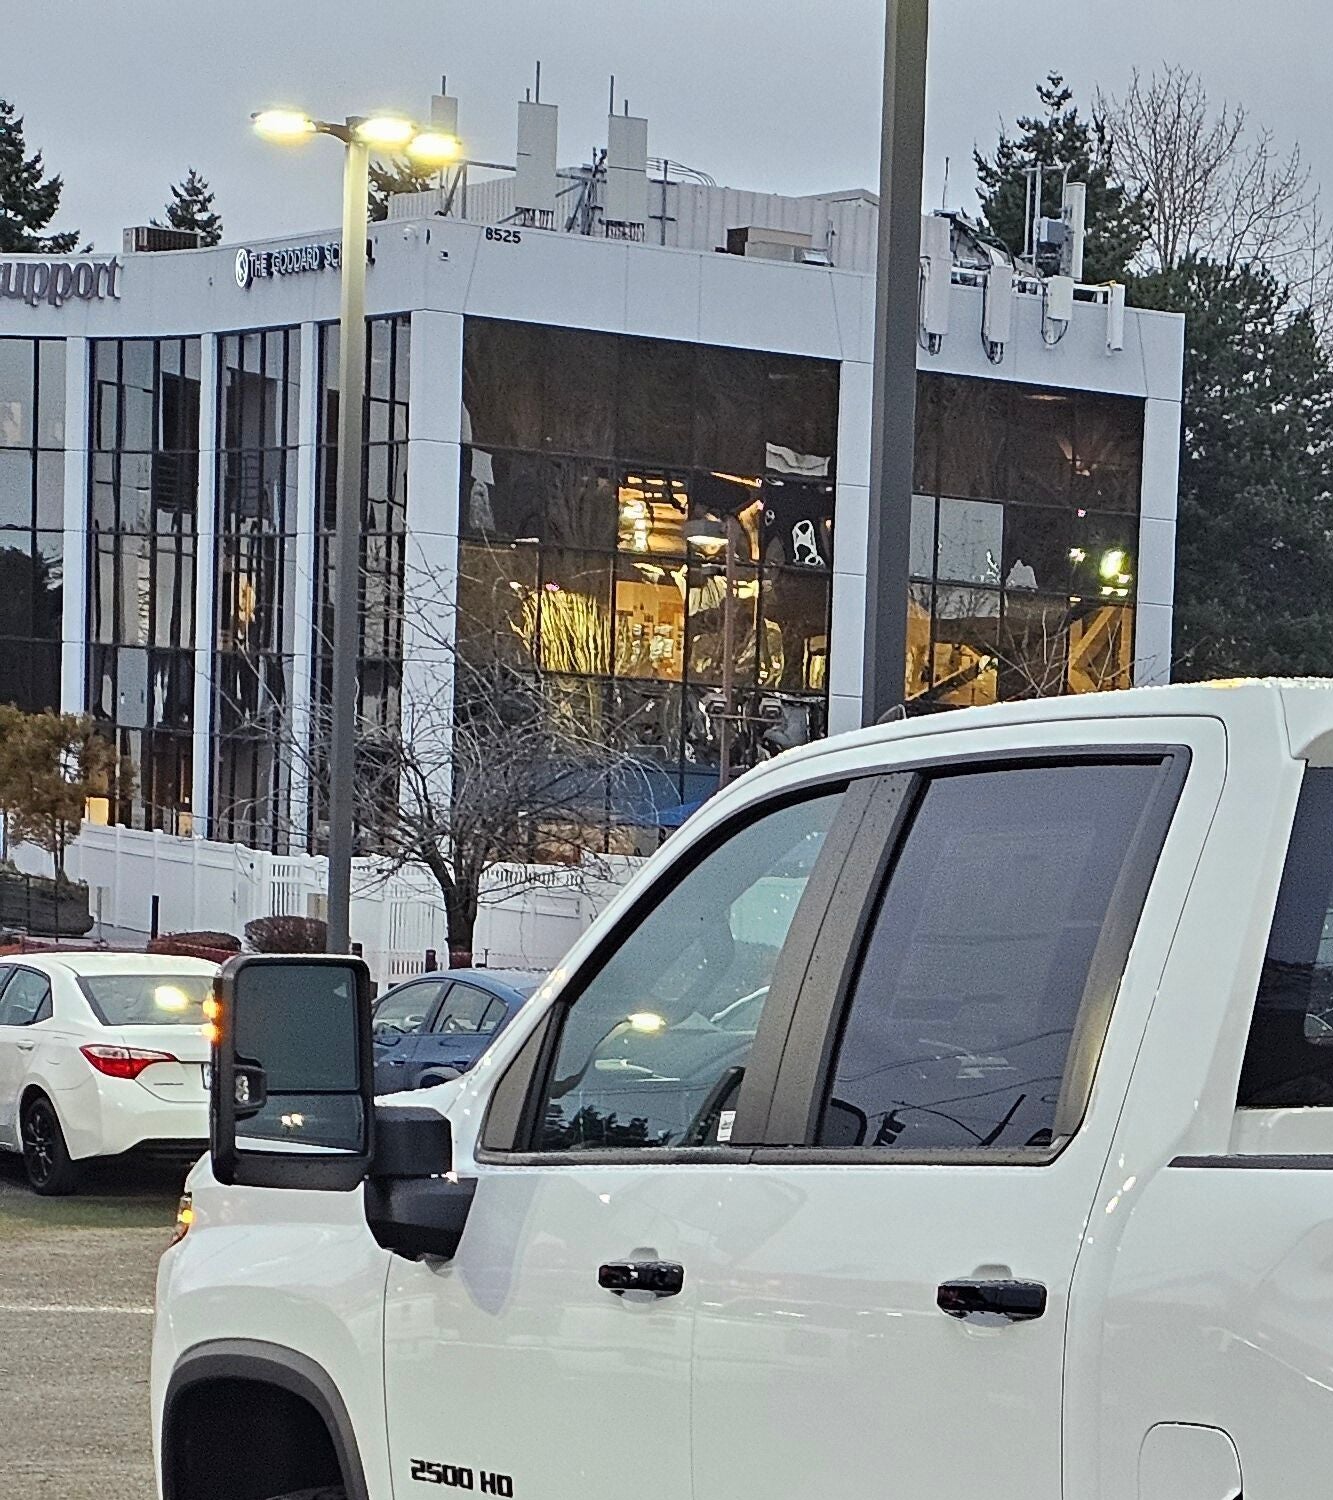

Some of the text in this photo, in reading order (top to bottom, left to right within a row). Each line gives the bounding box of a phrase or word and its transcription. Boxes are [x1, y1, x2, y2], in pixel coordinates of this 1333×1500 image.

[485, 226, 522, 244] 8525
[249, 250, 268, 277] THE
[270, 245, 321, 275] GODDARD
[0, 256, 124, 308] upport
[410, 1458, 513, 1498] 2500 HD
